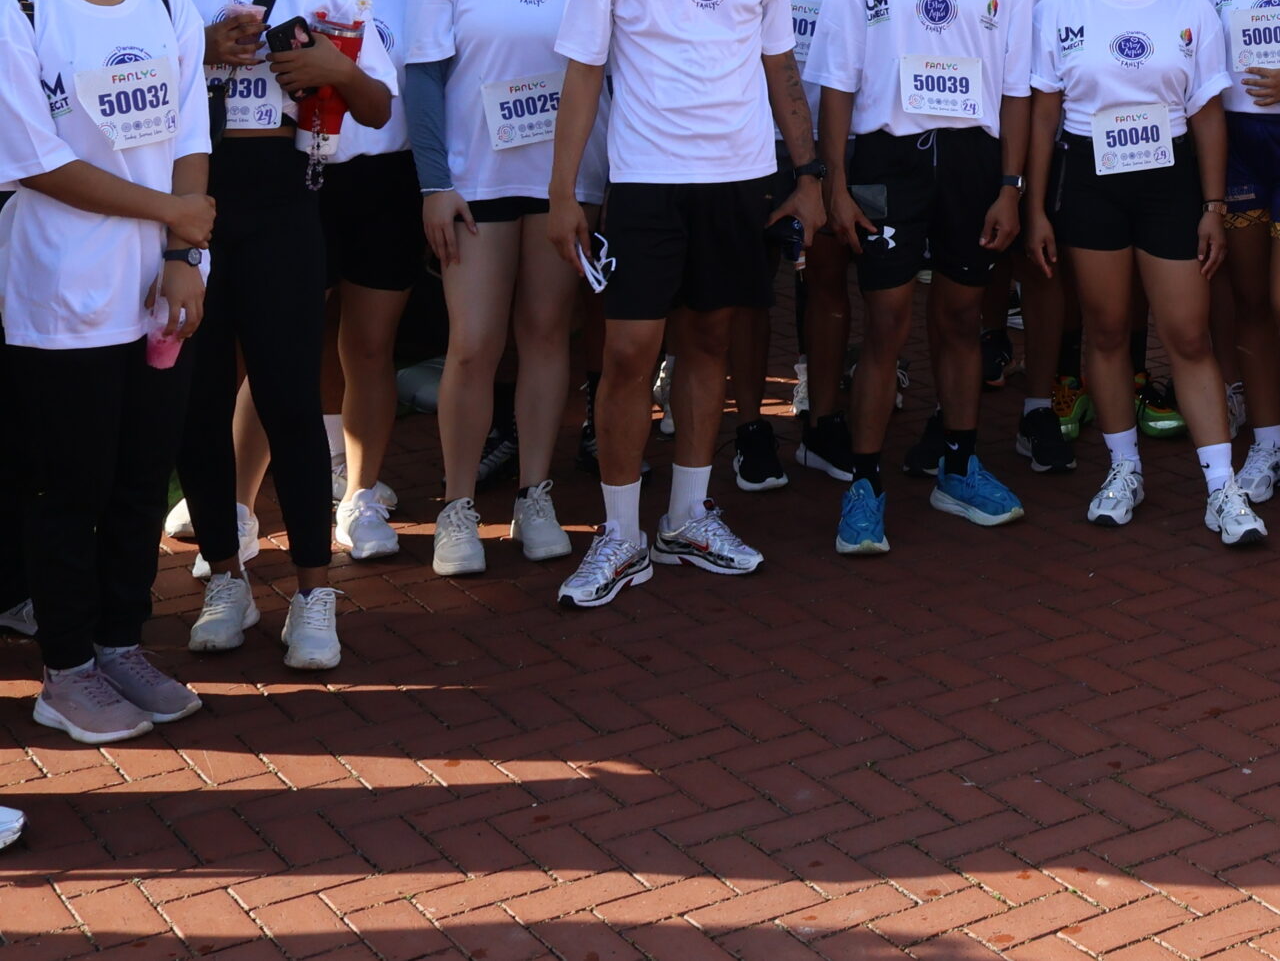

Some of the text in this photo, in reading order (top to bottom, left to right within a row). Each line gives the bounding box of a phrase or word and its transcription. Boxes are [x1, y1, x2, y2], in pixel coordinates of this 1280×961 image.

[696, 1, 721, 11] FANLYC
[926, 25, 947, 35] FANLYC
[925, 61, 958, 71] FANLYC
[1121, 60, 1145, 69] FANLYC
[112, 68, 157, 84] FANLYC
[509, 81, 547, 94] FANLYC
[913, 74, 970, 94] 50039
[98, 82, 170, 117] 50032
[500, 92, 560, 121] 50025
[962, 101, 976, 115] 24
[165, 114, 176, 130] 24
[256, 108, 273, 125] 24
[1115, 113, 1149, 123] FANLYC
[1105, 124, 1160, 148] 50040
